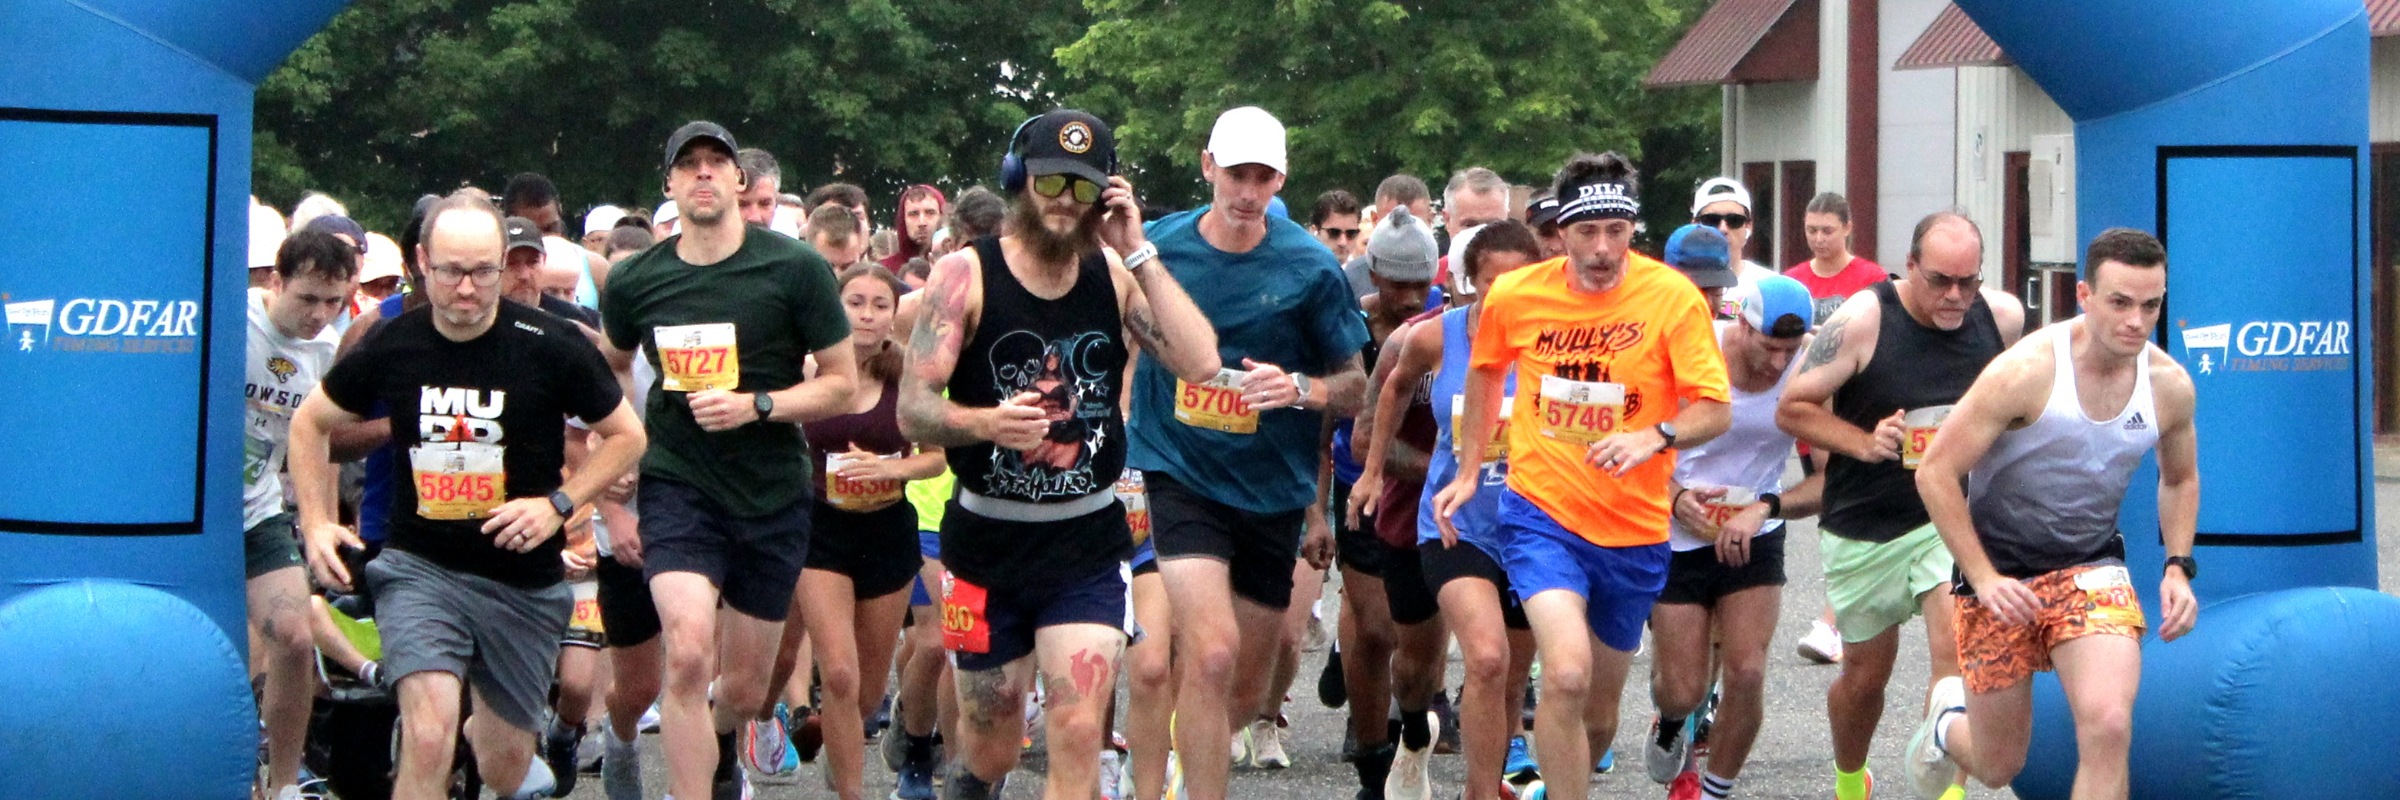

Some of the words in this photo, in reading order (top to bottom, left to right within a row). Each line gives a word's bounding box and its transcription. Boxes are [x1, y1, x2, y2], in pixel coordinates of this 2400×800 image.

[1578, 183, 1625, 198] DILF
[59, 298, 198, 336] GDFAR
[1535, 321, 1646, 357] MULLY'S
[2236, 321, 2350, 356] GDFAR
[666, 347, 728, 374] 5727
[1183, 383, 1251, 417] 5706
[1547, 400, 1614, 432] 5746
[1912, 427, 1938, 453] 5
[420, 473, 495, 502] 5845
[1703, 504, 1745, 527] 76
